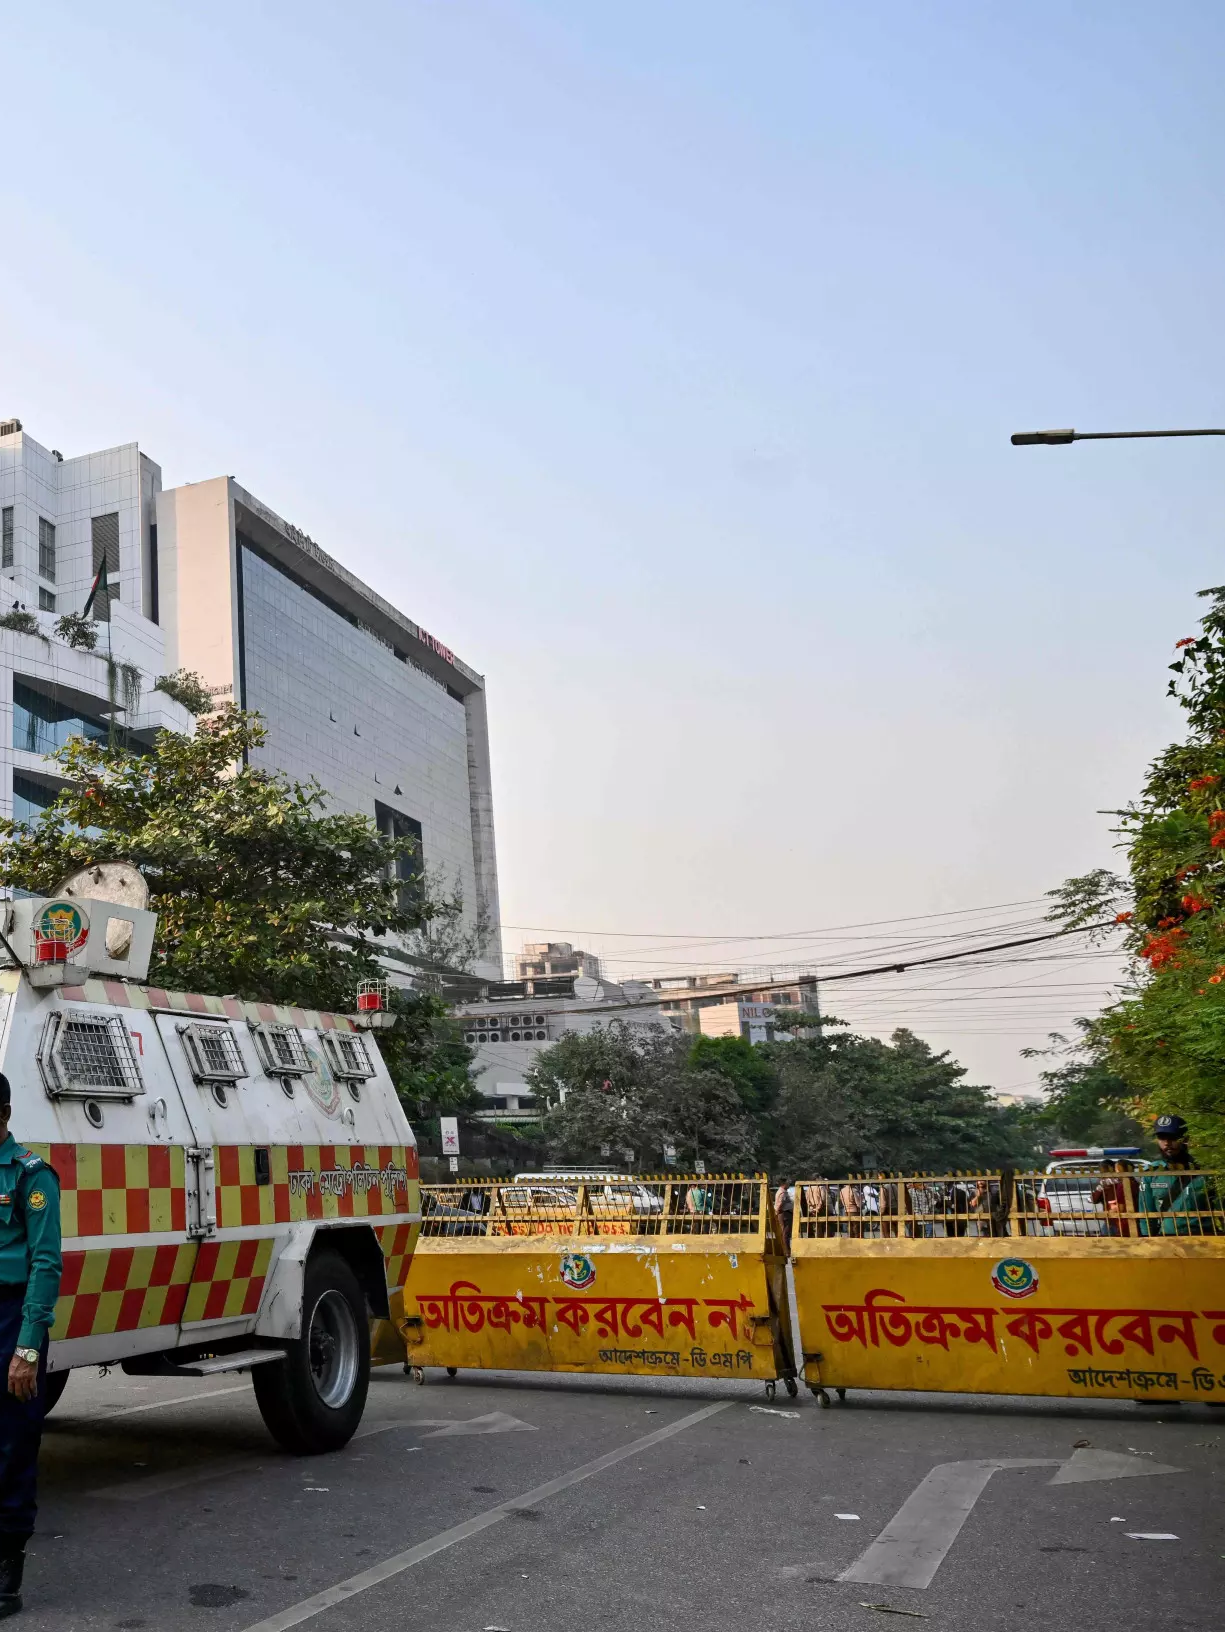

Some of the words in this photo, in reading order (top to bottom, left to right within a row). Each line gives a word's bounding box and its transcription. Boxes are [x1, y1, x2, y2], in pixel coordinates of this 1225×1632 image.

[288, 1168, 316, 1198] ঢাকা
[380, 1161, 408, 1201] পুলিশ
[415, 1280, 551, 1336] অতিক্রম
[552, 1297, 700, 1341] করবেন
[702, 1293, 756, 1341] না
[821, 1289, 1000, 1355] অতিক্রম
[1000, 1307, 1200, 1361] করবেন
[598, 1349, 680, 1368] আদেশক্রমে
[1067, 1366, 1178, 1391] আদেশক্রমে
